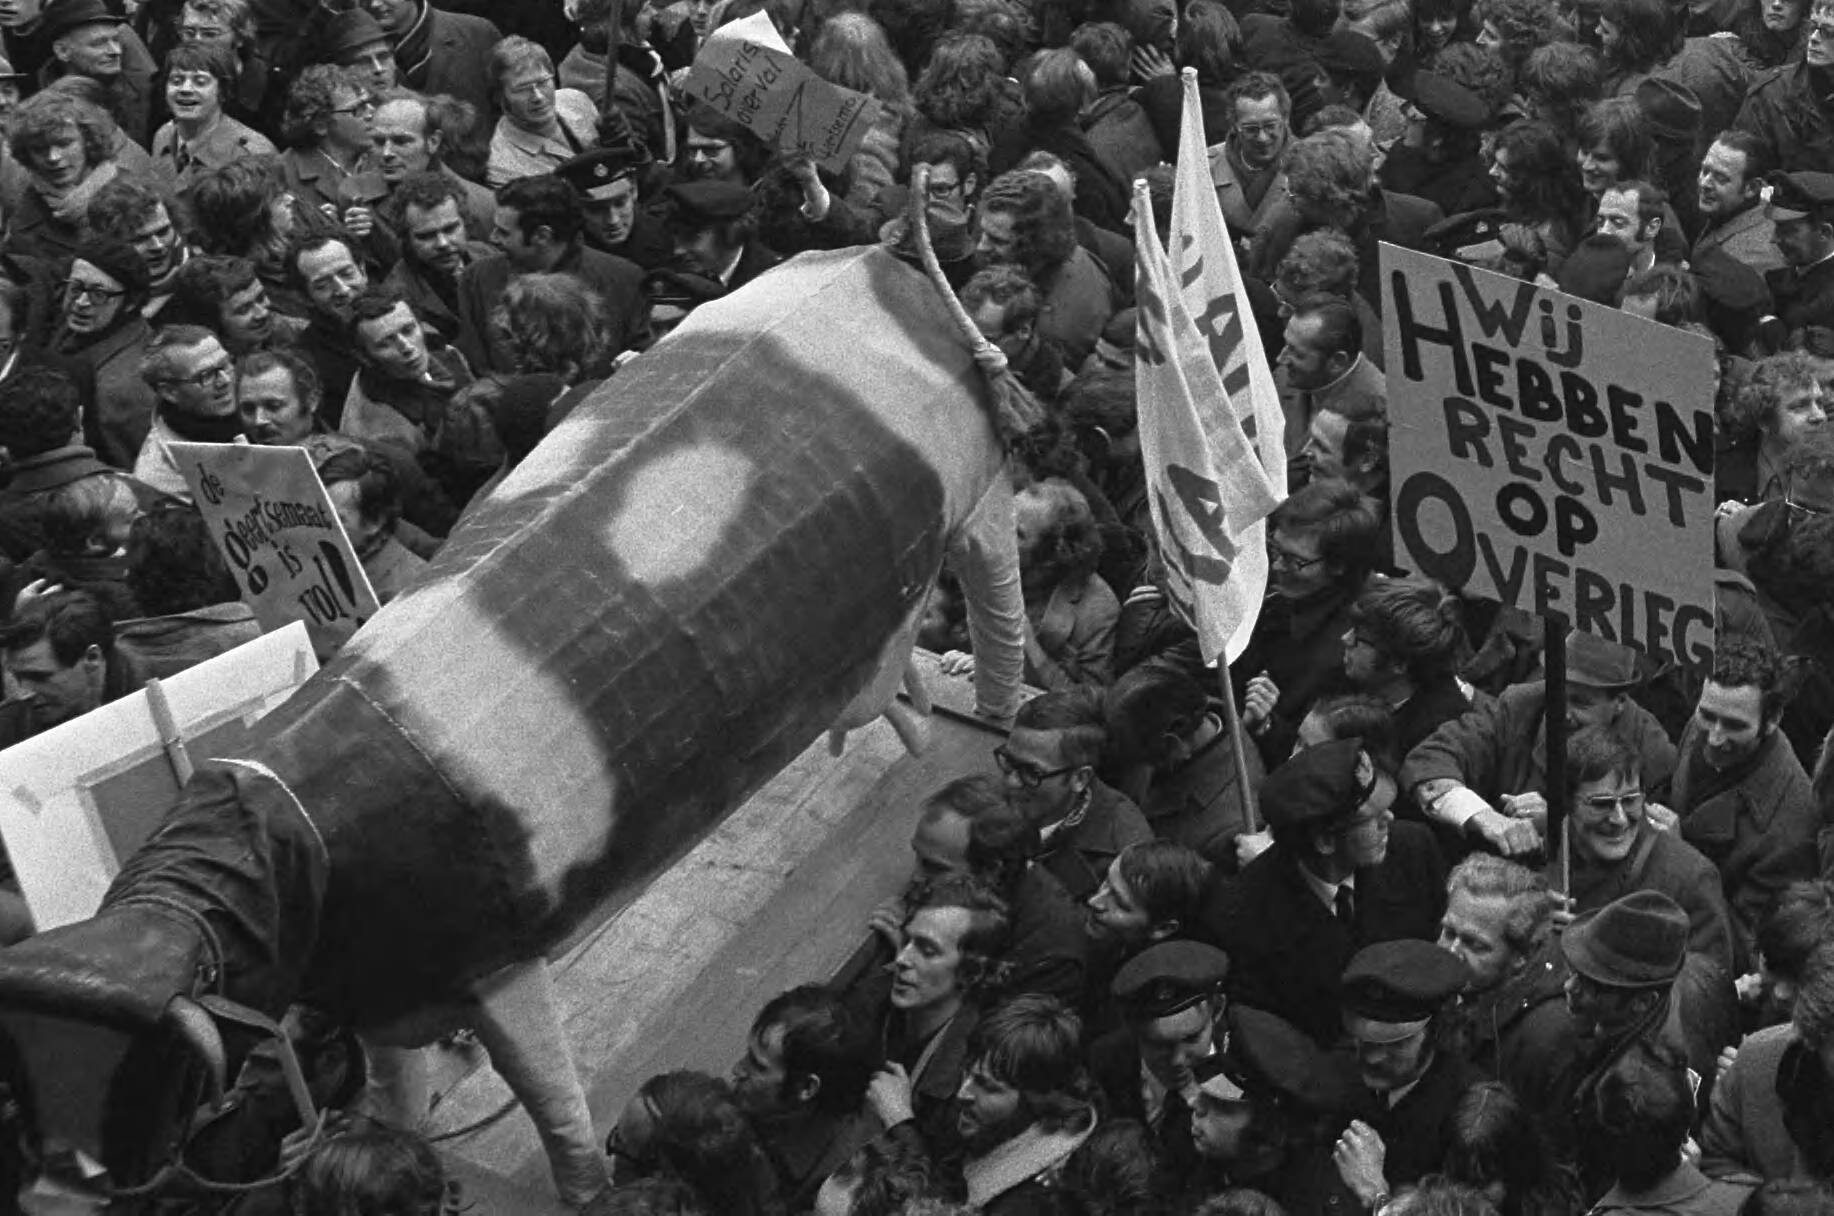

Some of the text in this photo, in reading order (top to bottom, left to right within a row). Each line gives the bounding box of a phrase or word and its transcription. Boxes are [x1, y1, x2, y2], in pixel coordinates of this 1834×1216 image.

[1391, 269, 1714, 476] HEBBEN
[196, 461, 225, 506] de
[1444, 397, 1707, 528] RECHT
[271, 539, 303, 580] is
[1495, 481, 1598, 558] OP
[1400, 471, 1715, 678] OVERLEG
